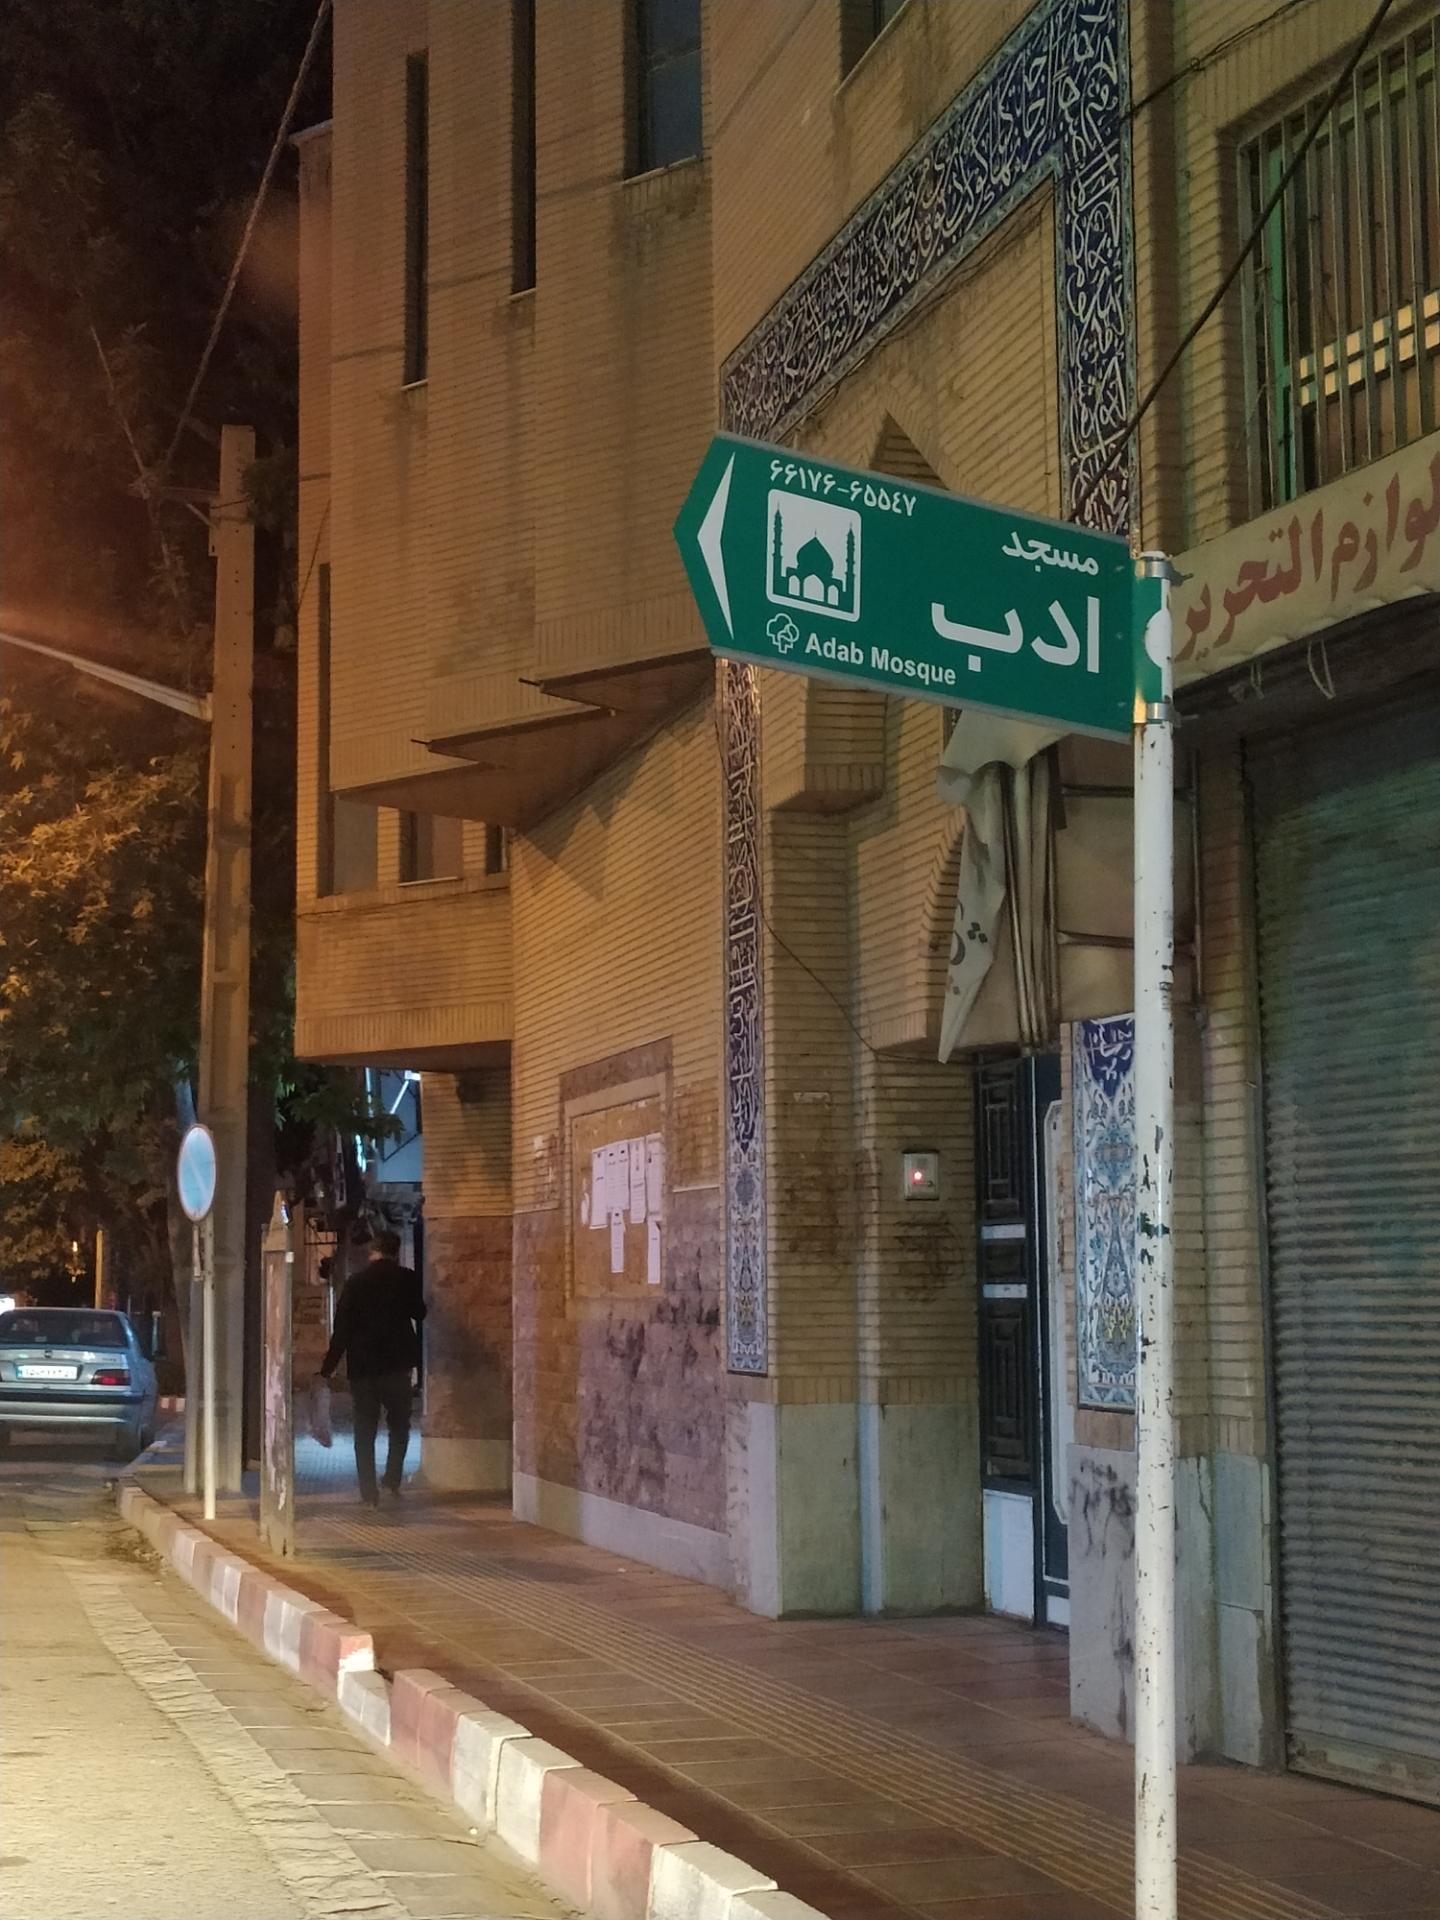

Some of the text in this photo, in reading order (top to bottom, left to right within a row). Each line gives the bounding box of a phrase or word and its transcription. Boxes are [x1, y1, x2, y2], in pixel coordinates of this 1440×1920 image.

[1001, 531, 1099, 576] مسجد
[804, 632, 957, 686] Adab Mosque
[931, 595, 1100, 674] ادب
